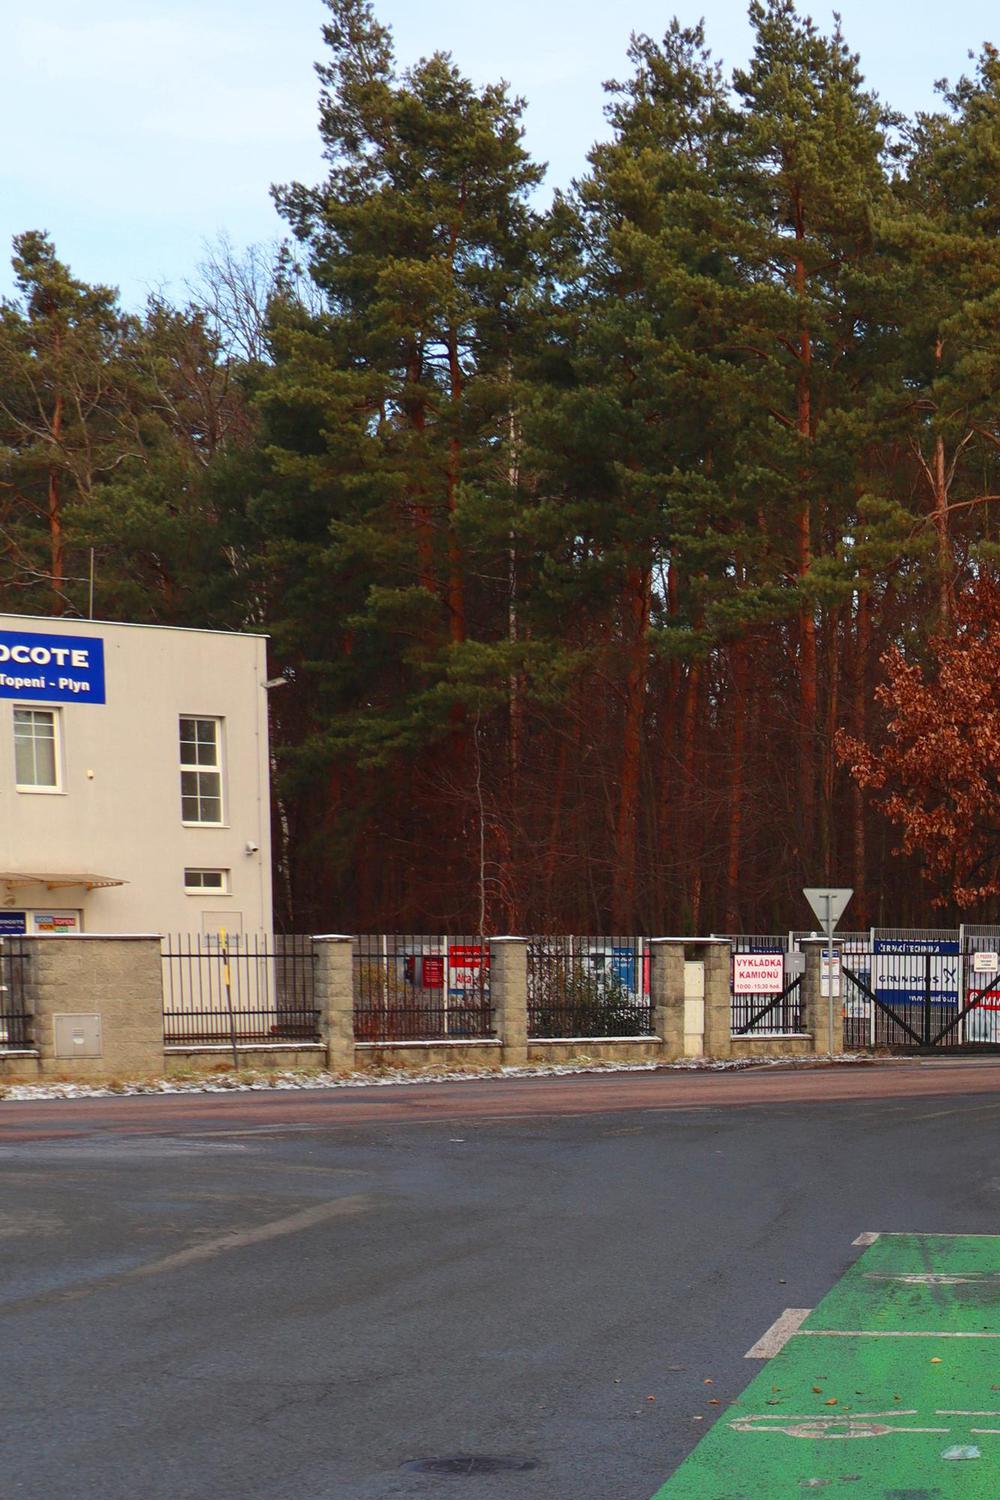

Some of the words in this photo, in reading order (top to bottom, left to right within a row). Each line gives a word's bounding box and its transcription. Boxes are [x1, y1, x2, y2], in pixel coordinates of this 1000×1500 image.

[58, 677, 91, 693] Plyn
[737, 958, 782, 967] VYKLÁDKA
[879, 975, 940, 984] GRUNDFS
